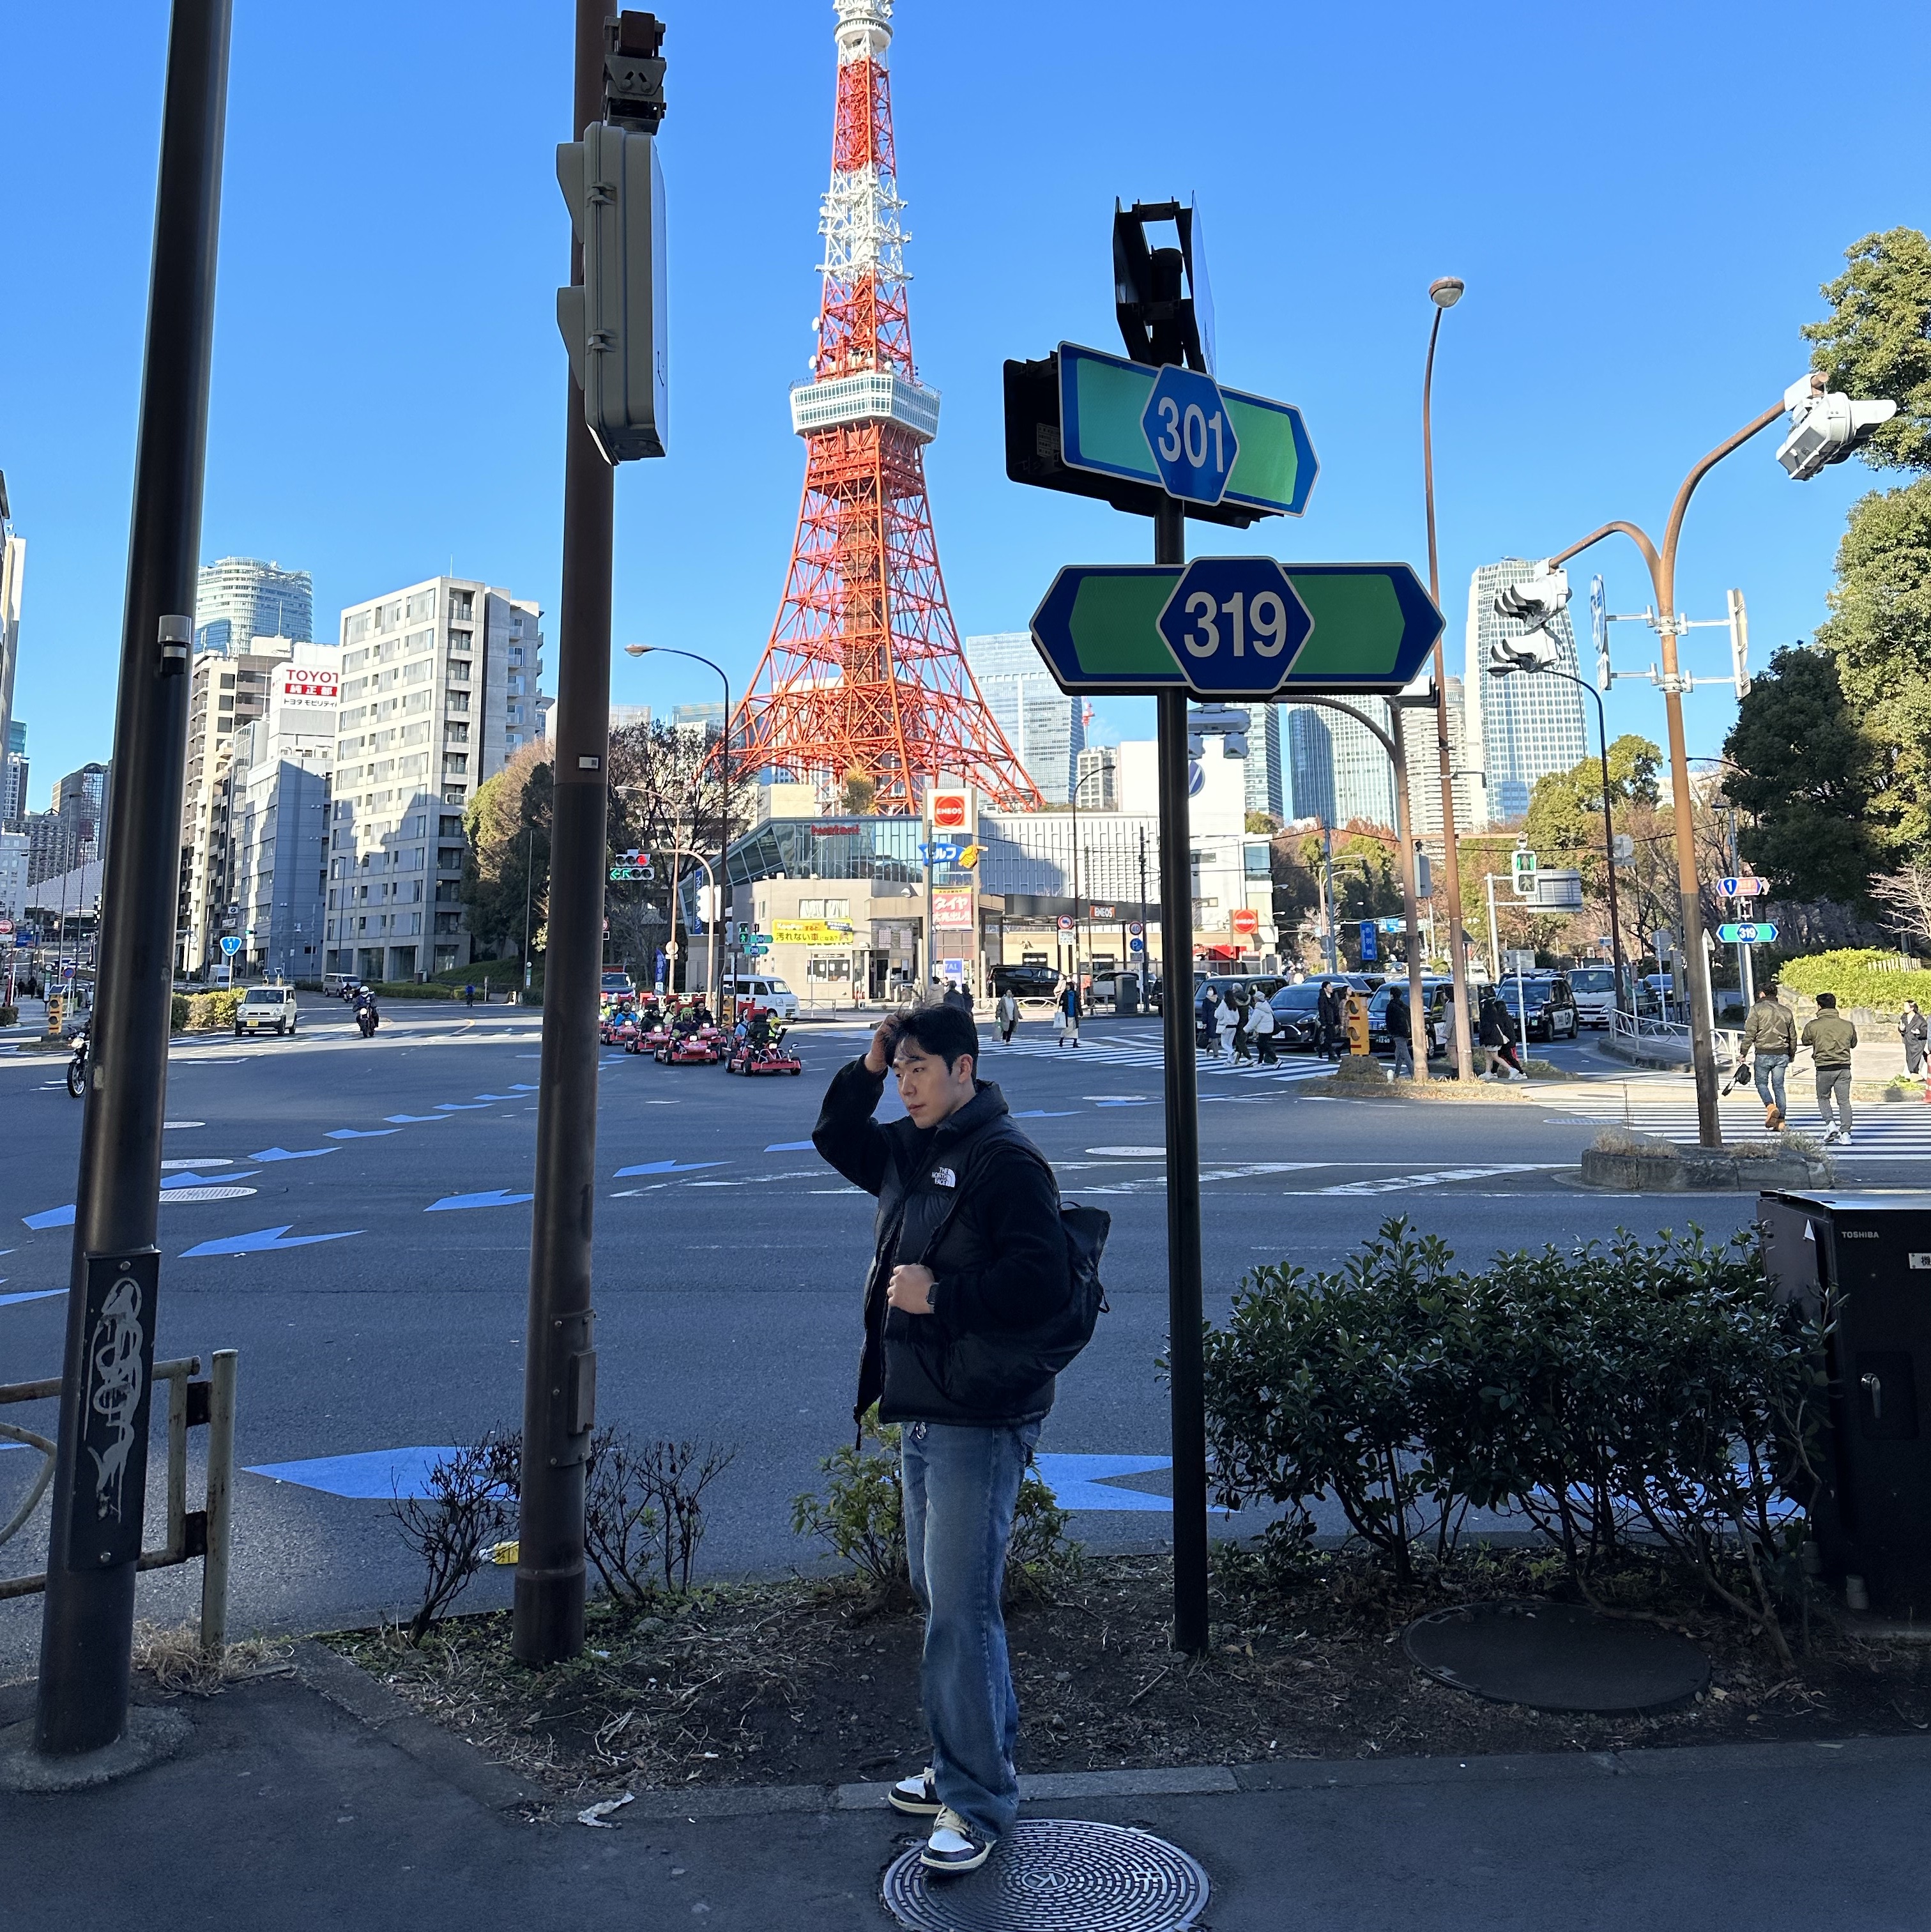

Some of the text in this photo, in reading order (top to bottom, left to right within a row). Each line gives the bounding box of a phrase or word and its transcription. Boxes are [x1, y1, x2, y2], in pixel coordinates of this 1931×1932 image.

[1157, 396, 1225, 473] 301
[1184, 591, 1287, 658] 319
[1727, 880, 1732, 893] 1
[934, 896, 968, 910] タイヤ
[1094, 907, 1113, 917] ENEOS
[1739, 928, 1756, 939] 319
